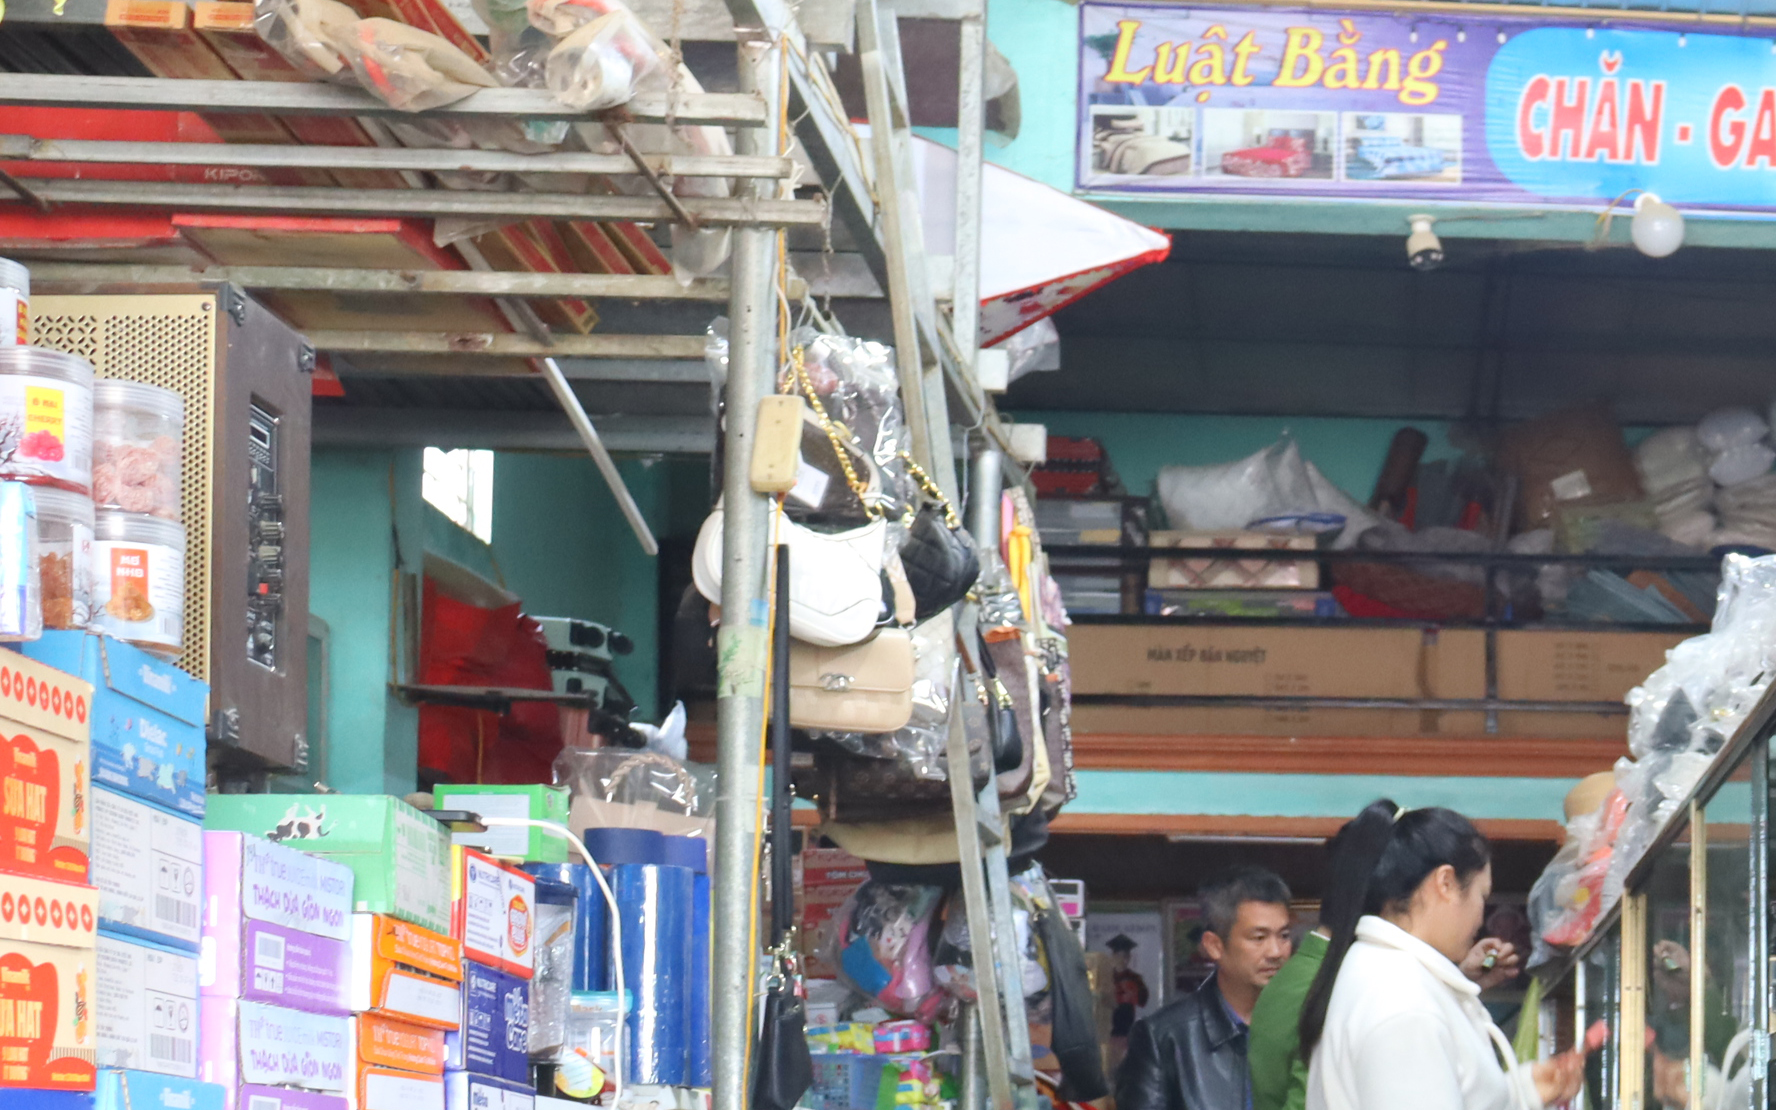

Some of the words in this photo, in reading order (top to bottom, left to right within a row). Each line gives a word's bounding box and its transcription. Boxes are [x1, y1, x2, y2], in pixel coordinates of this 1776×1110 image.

[1105, 20, 1262, 103] Luật
[1272, 18, 1446, 106] Bằng
[1518, 50, 1663, 164] CHĂN
